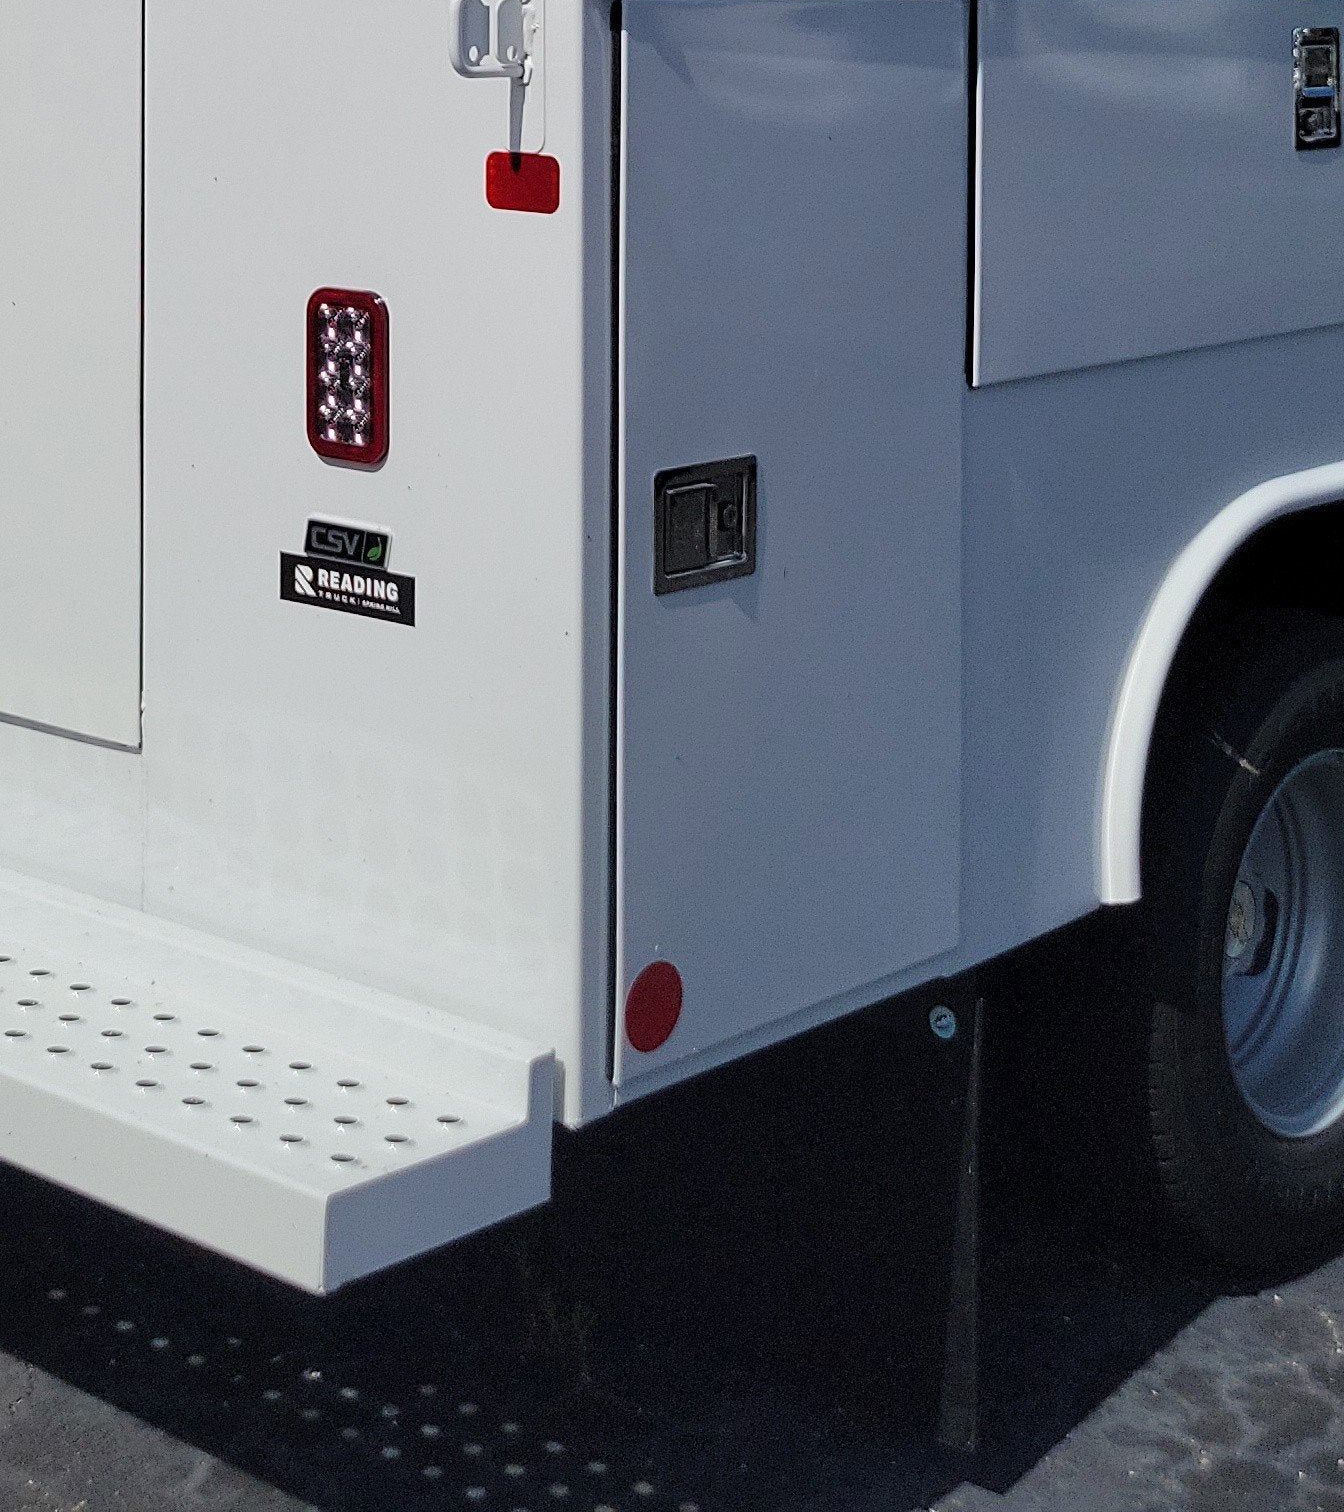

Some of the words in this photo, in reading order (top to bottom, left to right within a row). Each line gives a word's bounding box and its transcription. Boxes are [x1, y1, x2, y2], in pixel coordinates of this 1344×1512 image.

[310, 526, 360, 556] CSV
[317, 568, 399, 602] READING
[318, 589, 357, 606] TRUCK
